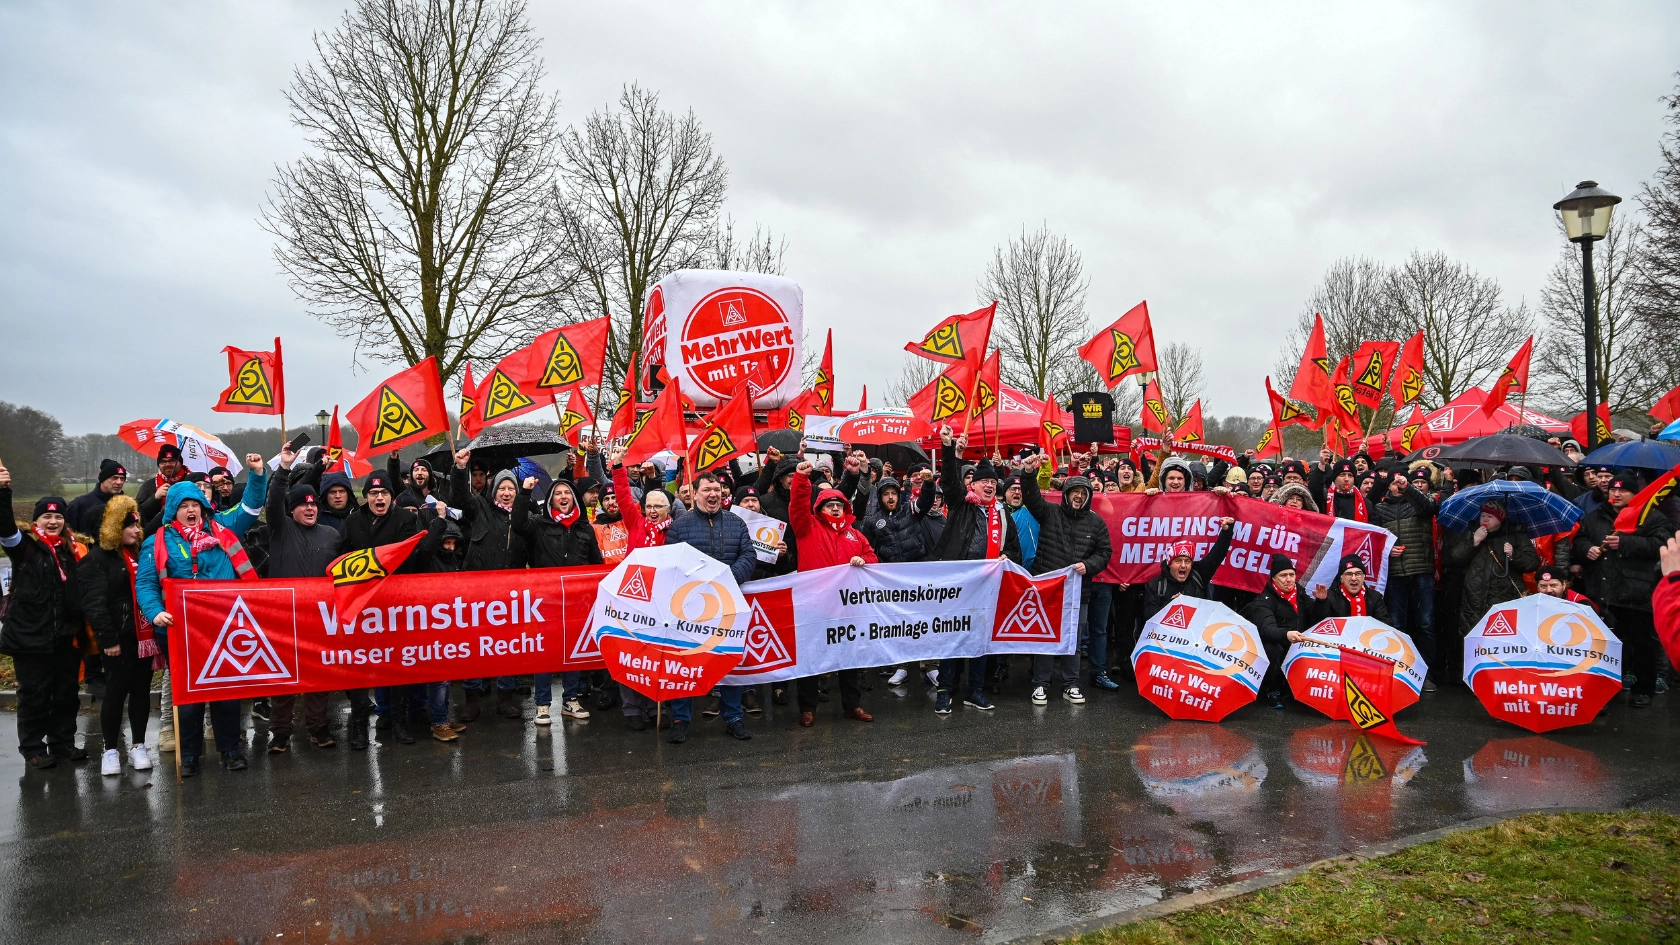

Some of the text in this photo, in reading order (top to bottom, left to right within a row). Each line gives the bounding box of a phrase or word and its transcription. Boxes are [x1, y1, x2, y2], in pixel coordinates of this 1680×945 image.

[680, 326, 794, 365] MehrWert
[708, 354, 779, 382] mit Taf
[858, 424, 908, 436] mit Tarif
[1138, 438, 1158, 446] YOU
[1122, 516, 1302, 553] GEMEINSM FÜR
[839, 584, 962, 606] Vertrauenskörper
[604, 606, 746, 639] HOLZ UND KUNSTSTOFF
[826, 624, 856, 645] RPC
[869, 620, 928, 640] Bramlage
[932, 615, 972, 634] GmbH
[321, 632, 544, 666] unser gutes Recht
[1146, 632, 1262, 680] HOLZ UND KUNSTSTOFF
[1474, 644, 1620, 666] HOLZ UND KUNSTSTOFF
[619, 651, 704, 678] Mehr Wert
[626, 673, 697, 692] mit Tarif
[1149, 664, 1222, 698] Mehr Wert
[1310, 685, 1334, 699] mit
[1494, 681, 1583, 699] Mehr Wert
[1152, 684, 1213, 712] mit Tarif
[1504, 699, 1579, 716] mit Tarif
